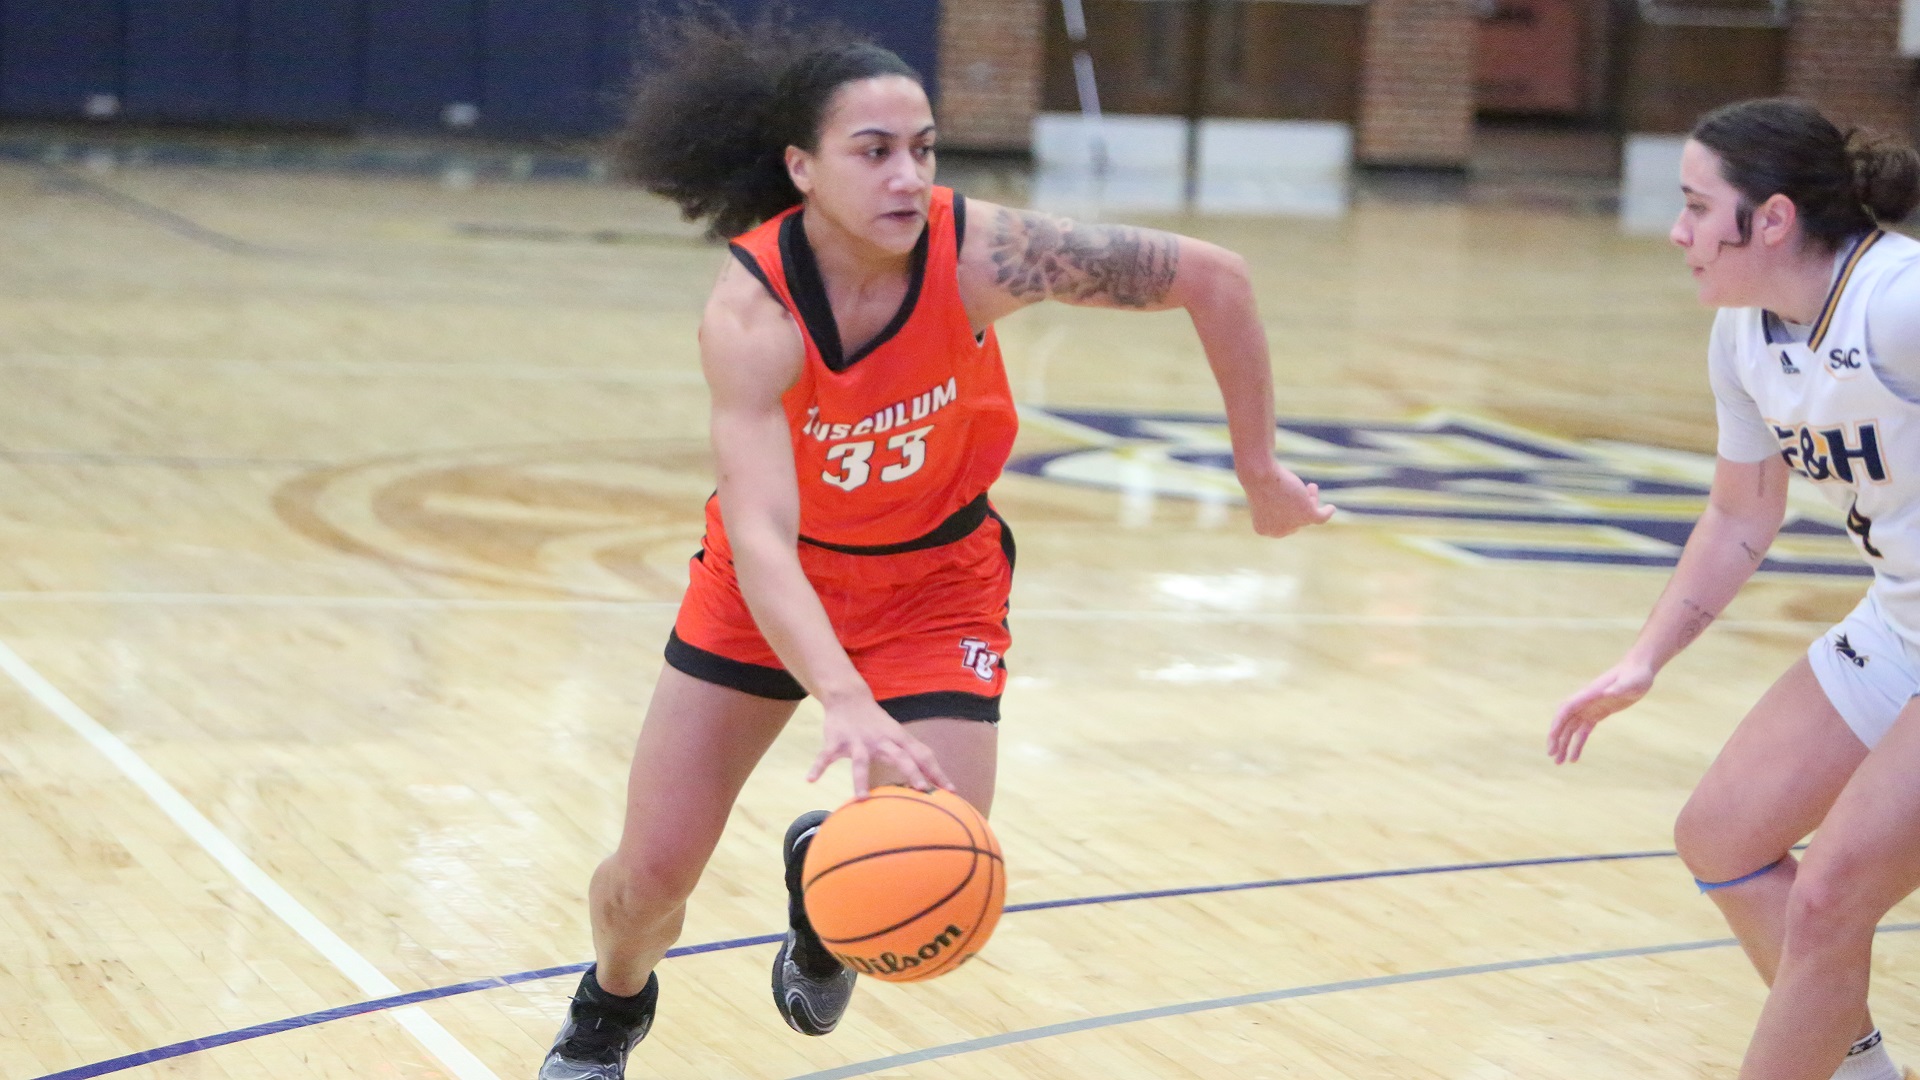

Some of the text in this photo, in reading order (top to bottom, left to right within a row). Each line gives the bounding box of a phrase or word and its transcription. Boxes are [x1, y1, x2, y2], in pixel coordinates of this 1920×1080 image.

[803, 377, 957, 441] TUSCULUM
[821, 424, 935, 491] 33
[959, 636, 1000, 682] TU
